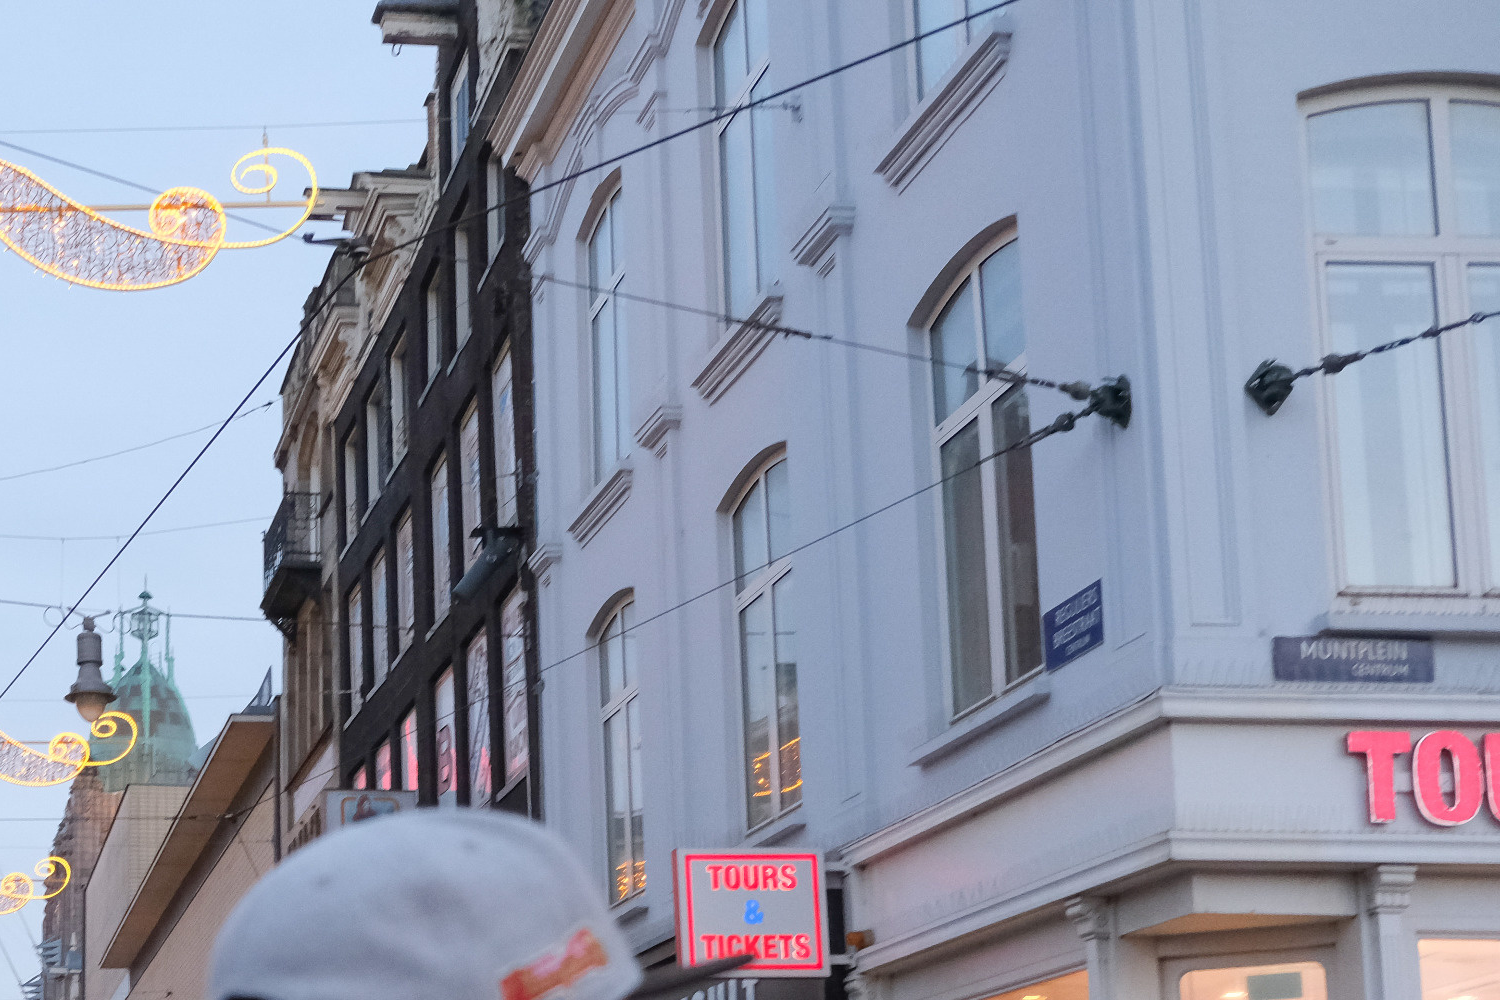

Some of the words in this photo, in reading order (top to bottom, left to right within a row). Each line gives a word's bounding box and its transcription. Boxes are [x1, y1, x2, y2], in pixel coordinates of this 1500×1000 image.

[1300, 640, 1408, 661] MUNTPLEIN
[1348, 730, 1500, 827] TO
[706, 864, 798, 891] TOURS
[743, 899, 764, 925] &
[700, 933, 812, 960] TICKETS
